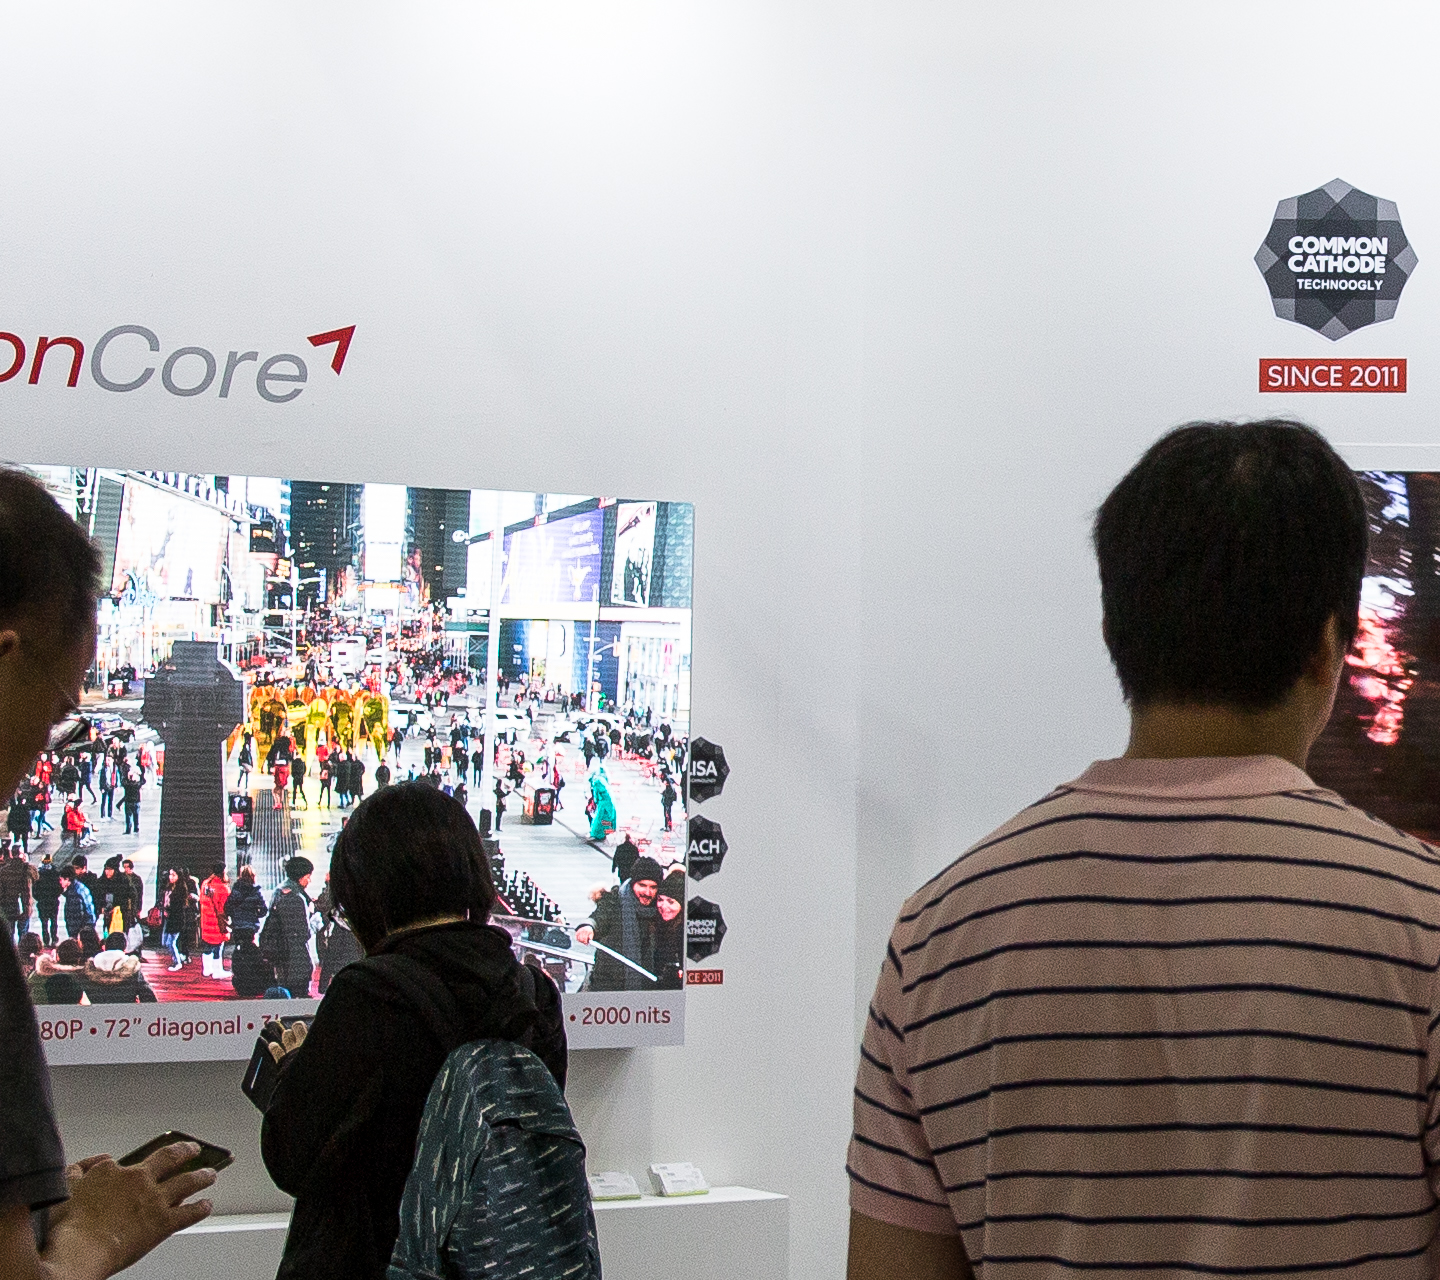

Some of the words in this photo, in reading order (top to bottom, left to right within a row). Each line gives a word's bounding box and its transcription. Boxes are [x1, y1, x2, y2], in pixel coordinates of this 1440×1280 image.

[1288, 236, 1388, 255] COMMON
[1288, 255, 1386, 273] CATHODE
[1268, 365, 1343, 387] SINCE
[1349, 365, 1399, 387] 2011
[147, 1014, 242, 1041] diagonal
[582, 1007, 630, 1026] 2000
[635, 1005, 672, 1025] nits
